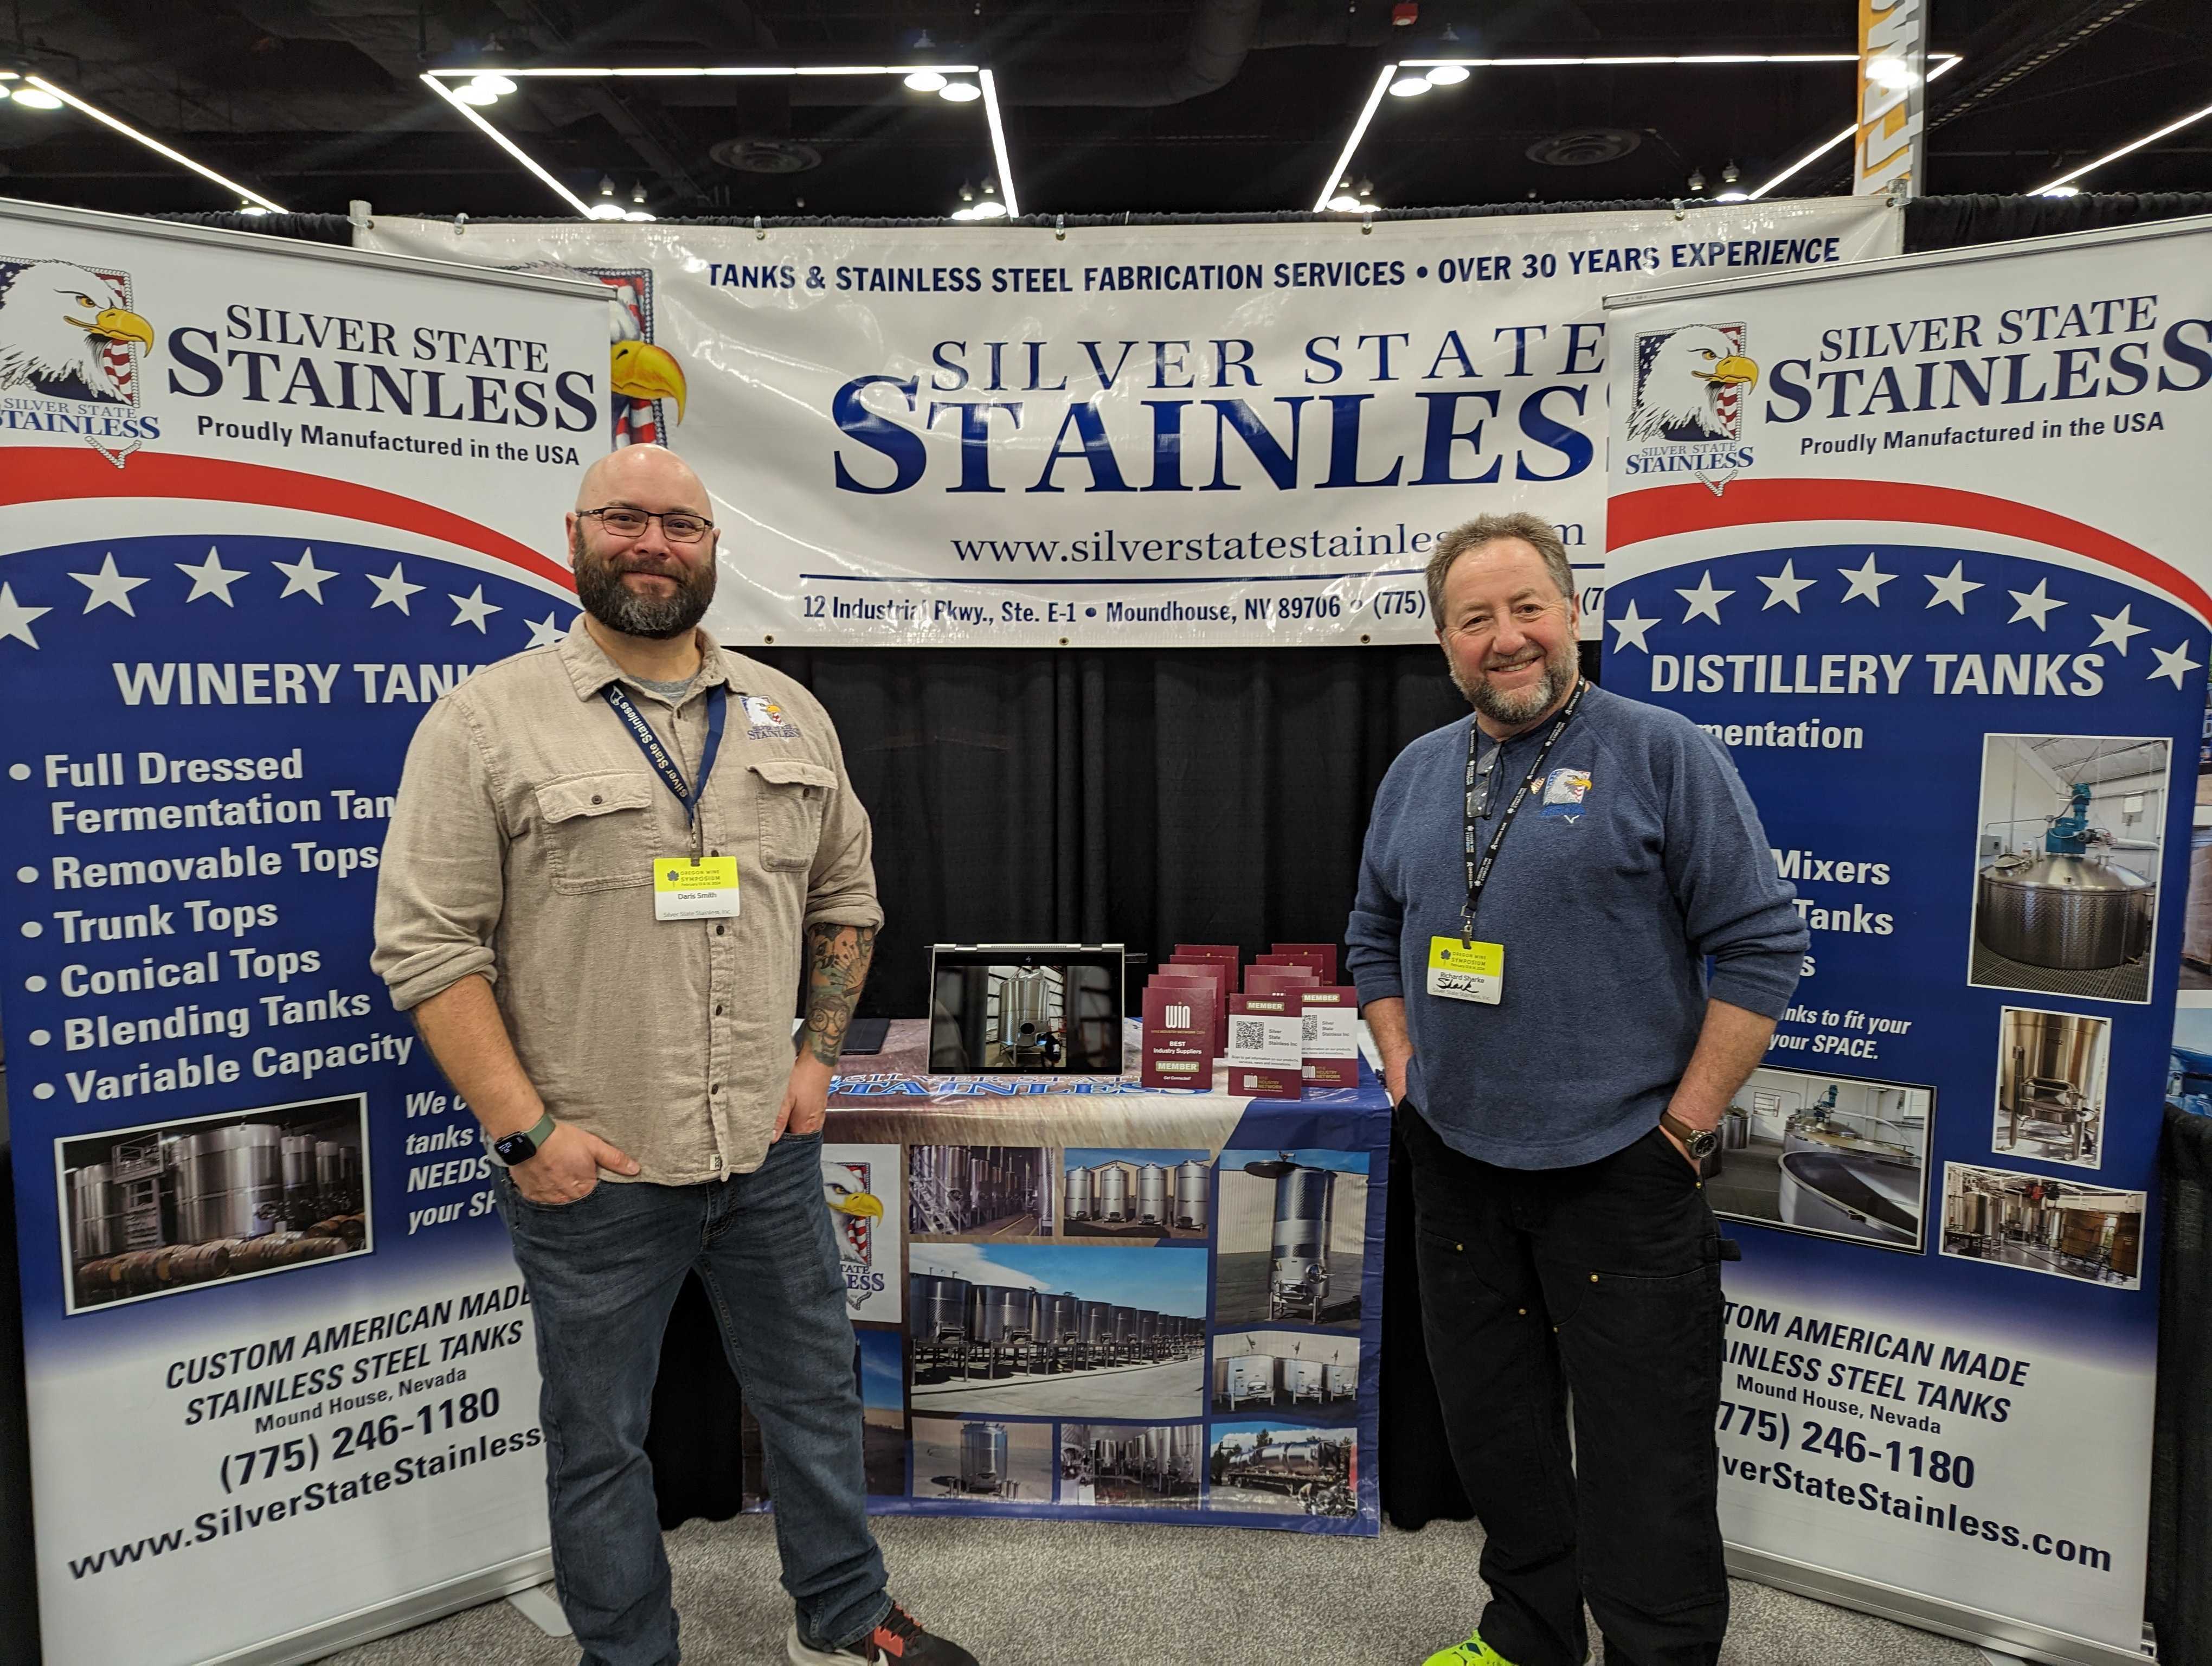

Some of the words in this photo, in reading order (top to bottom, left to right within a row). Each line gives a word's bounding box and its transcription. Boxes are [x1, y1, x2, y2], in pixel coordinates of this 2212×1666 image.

[708, 262, 795, 290] TANKS
[806, 265, 826, 290] &
[835, 266, 981, 293] STAINLESS
[991, 264, 1072, 293] STEEL
[1084, 263, 1263, 292] FABRICATION
[1274, 260, 1405, 290] SERVICES
[1438, 255, 1512, 284] OVER
[1521, 254, 1557, 279] 30
[1566, 247, 1661, 276] YEARS
[1671, 236, 1840, 269] EXPERIENCE
[227, 304, 397, 357] SILVER
[413, 326, 549, 374] STATE
[1819, 316, 1981, 364] SILVER
[1998, 295, 2158, 343] STATE
[167, 325, 599, 433] STAINLESS
[930, 339, 1263, 393] SILVER
[1304, 321, 1605, 386] STATE
[1764, 318, 2212, 426] STAINLESS
[0, 410, 160, 440] TAINLESS
[4, 398, 69, 413] SILVER
[78, 403, 137, 418] STATE
[198, 415, 293, 447] Proudly
[300, 424, 463, 458] Manufactured
[469, 439, 490, 460] in
[496, 440, 530, 464] the
[536, 444, 580, 466] USA
[832, 374, 1610, 495] STAINLES
[1641, 445, 1686, 457] SILVER
[1692, 443, 1737, 453] STATE
[1800, 430, 1877, 457] Proudly
[1882, 421, 2036, 451] Manufactured
[2041, 418, 2064, 439] in
[2068, 415, 2106, 437] the
[2114, 410, 2165, 434] USA
[1625, 446, 1754, 475] STAINLESS
[803, 595, 825, 618] 12
[833, 596, 927, 620] Industrial
[935, 600, 994, 626] Pkwy.,
[1001, 601, 1039, 622] Ste.
[1048, 601, 1076, 623] E-1
[1107, 601, 1236, 625] Moundhouse,
[1245, 598, 1270, 620] NV
[1278, 595, 1340, 618] 89706
[1373, 589, 1426, 621] (775)
[112, 663, 340, 706] WINERY
[1650, 653, 1915, 696] DISTILLERY
[1926, 653, 2106, 697] TANKS
[620, 702, 653, 744] Stainless
[1695, 718, 1864, 750] mentation
[44, 753, 124, 788] Full
[138, 748, 304, 785] Dressed
[650, 743, 669, 769] State
[665, 769, 688, 798] Silver
[51, 793, 321, 835] Fermentation
[330, 789, 396, 821] Tan
[52, 845, 282, 890] Removable
[292, 842, 380, 879] Tops
[1771, 849, 1891, 886] Mixers
[54, 905, 175, 945] Trunk
[184, 900, 279, 938] Tops
[1792, 899, 1894, 935] Tanks
[60, 951, 219, 998] Conical
[229, 946, 321, 985] Tops
[1441, 972, 1463, 980] Richard
[1464, 975, 1484, 983] Sharke
[1451, 958, 1486, 966] SYMPOSIUM
[63, 1002, 250, 1052] Blending
[259, 989, 371, 1028] Tanks
[1780, 1004, 1818, 1025] nks
[1821, 1009, 1840, 1027] to
[1843, 1007, 1866, 1029] fit
[1867, 1018, 1912, 1035] your
[1768, 1033, 1810, 1052] your
[1811, 1034, 1879, 1060] SPACE.
[66, 1056, 241, 1105] Variable
[252, 1033, 414, 1080] Capacity
[843, 1073, 1004, 1083] SILVER
[1016, 1075, 1142, 1084] STAT
[406, 1090, 447, 1119] We
[406, 1124, 474, 1156] tanks
[407, 1154, 492, 1193] NEEDS
[408, 1201, 465, 1235] your
[841, 1264, 870, 1274] TATE
[165, 1336, 295, 1391] CUSTOM
[301, 1299, 452, 1360] AMERICAN
[1724, 1302, 1780, 1335] TOM
[1784, 1316, 1935, 1367] AMERICAN
[1940, 1347, 2031, 1388] MADE
[183, 1363, 343, 1427] STAINLESS
[351, 1338, 432, 1385] STEEL
[438, 1320, 524, 1363] TANKS
[1722, 1338, 1822, 1382] INLESS
[1827, 1363, 1907, 1403] STEEL
[1917, 1380, 2012, 1424] TANKS
[254, 1403, 322, 1434] Mound
[328, 1387, 394, 1418] House,
[398, 1368, 467, 1398] Nevada
[1737, 1374, 1796, 1403] Mound
[1802, 1387, 1864, 1420] House,
[1870, 1404, 1941, 1434] Nevada
[220, 1433, 320, 1495] (775)
[331, 1387, 500, 1460] 246-1180
[1719, 1400, 1789, 1450] 775)
[1801, 1420, 1976, 1490] 246-1180
[1718, 1447, 2111, 1573] verStateStainless.com
